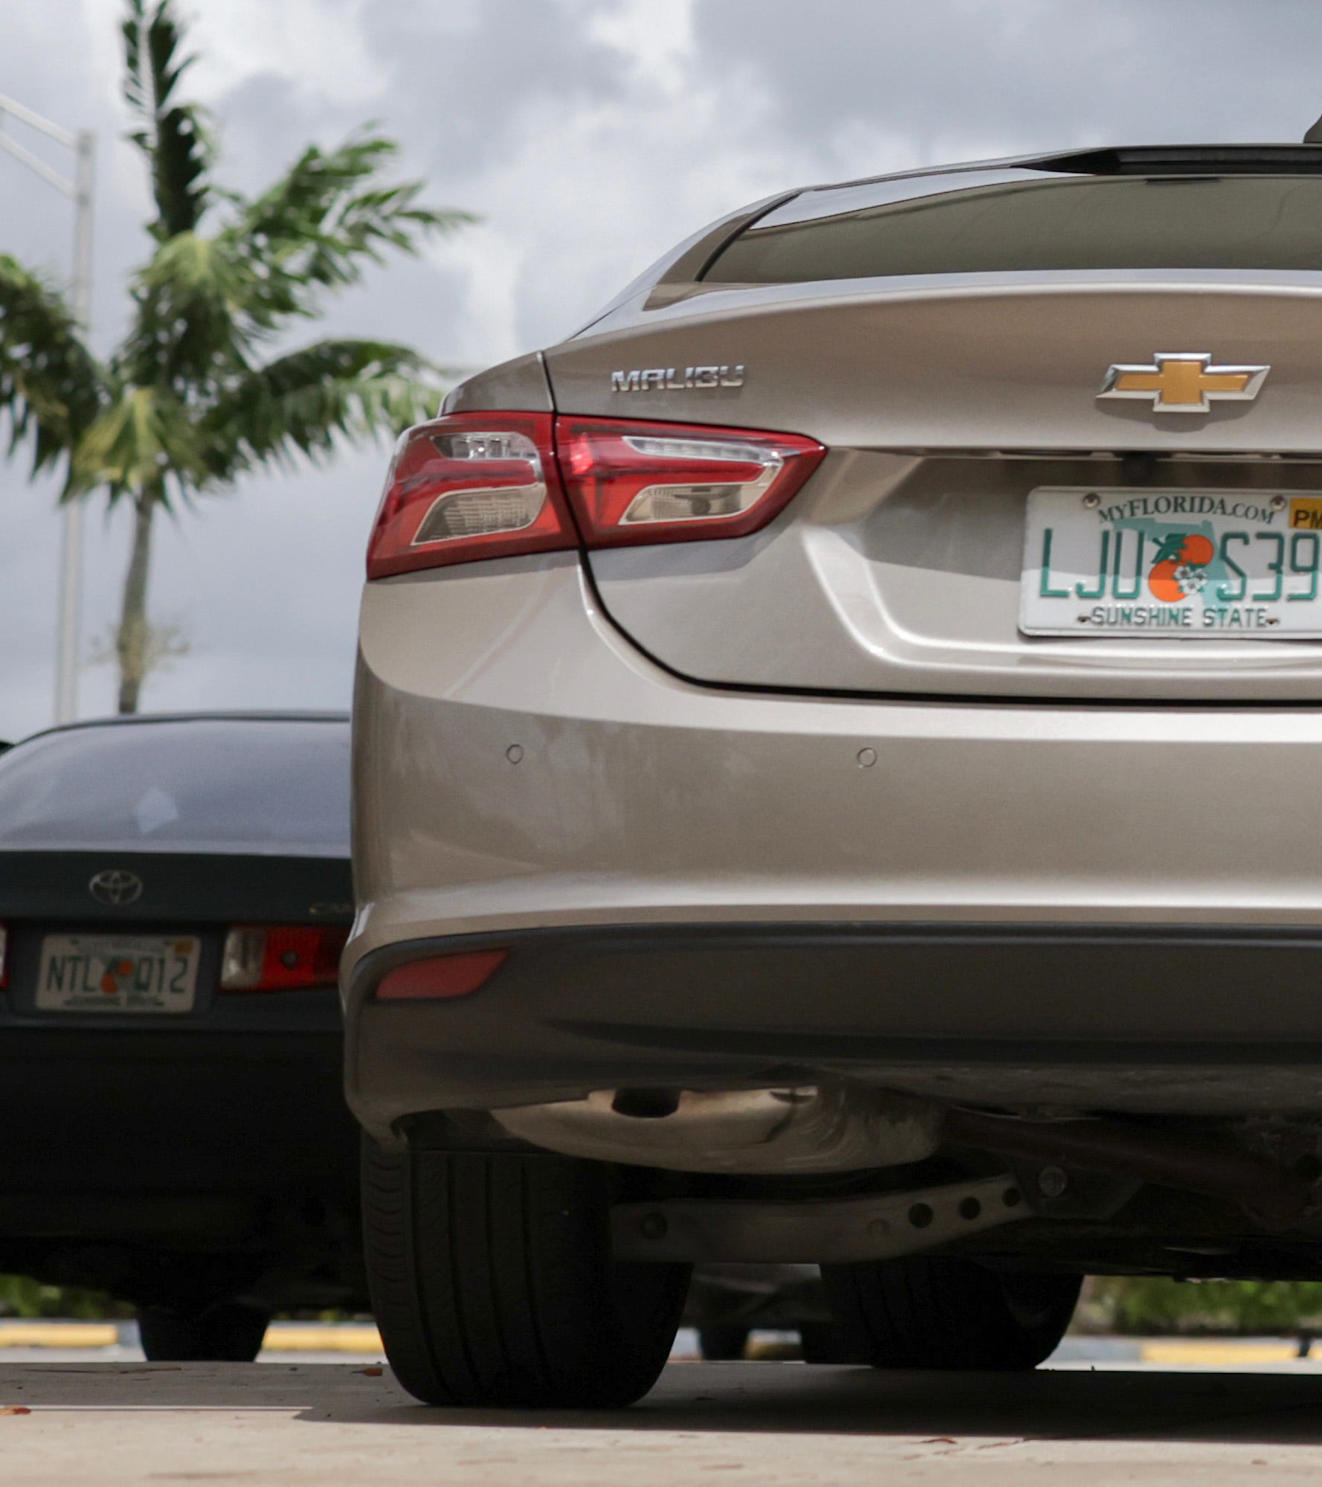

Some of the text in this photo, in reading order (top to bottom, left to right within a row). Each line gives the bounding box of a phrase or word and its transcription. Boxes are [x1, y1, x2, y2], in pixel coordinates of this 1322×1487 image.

[611, 365, 744, 392] MALIBU
[1098, 495, 1275, 525] MYFLORIDA.COM
[1040, 528, 1320, 601] LJU S39
[1091, 606, 1268, 628] SUNSHINE STATE
